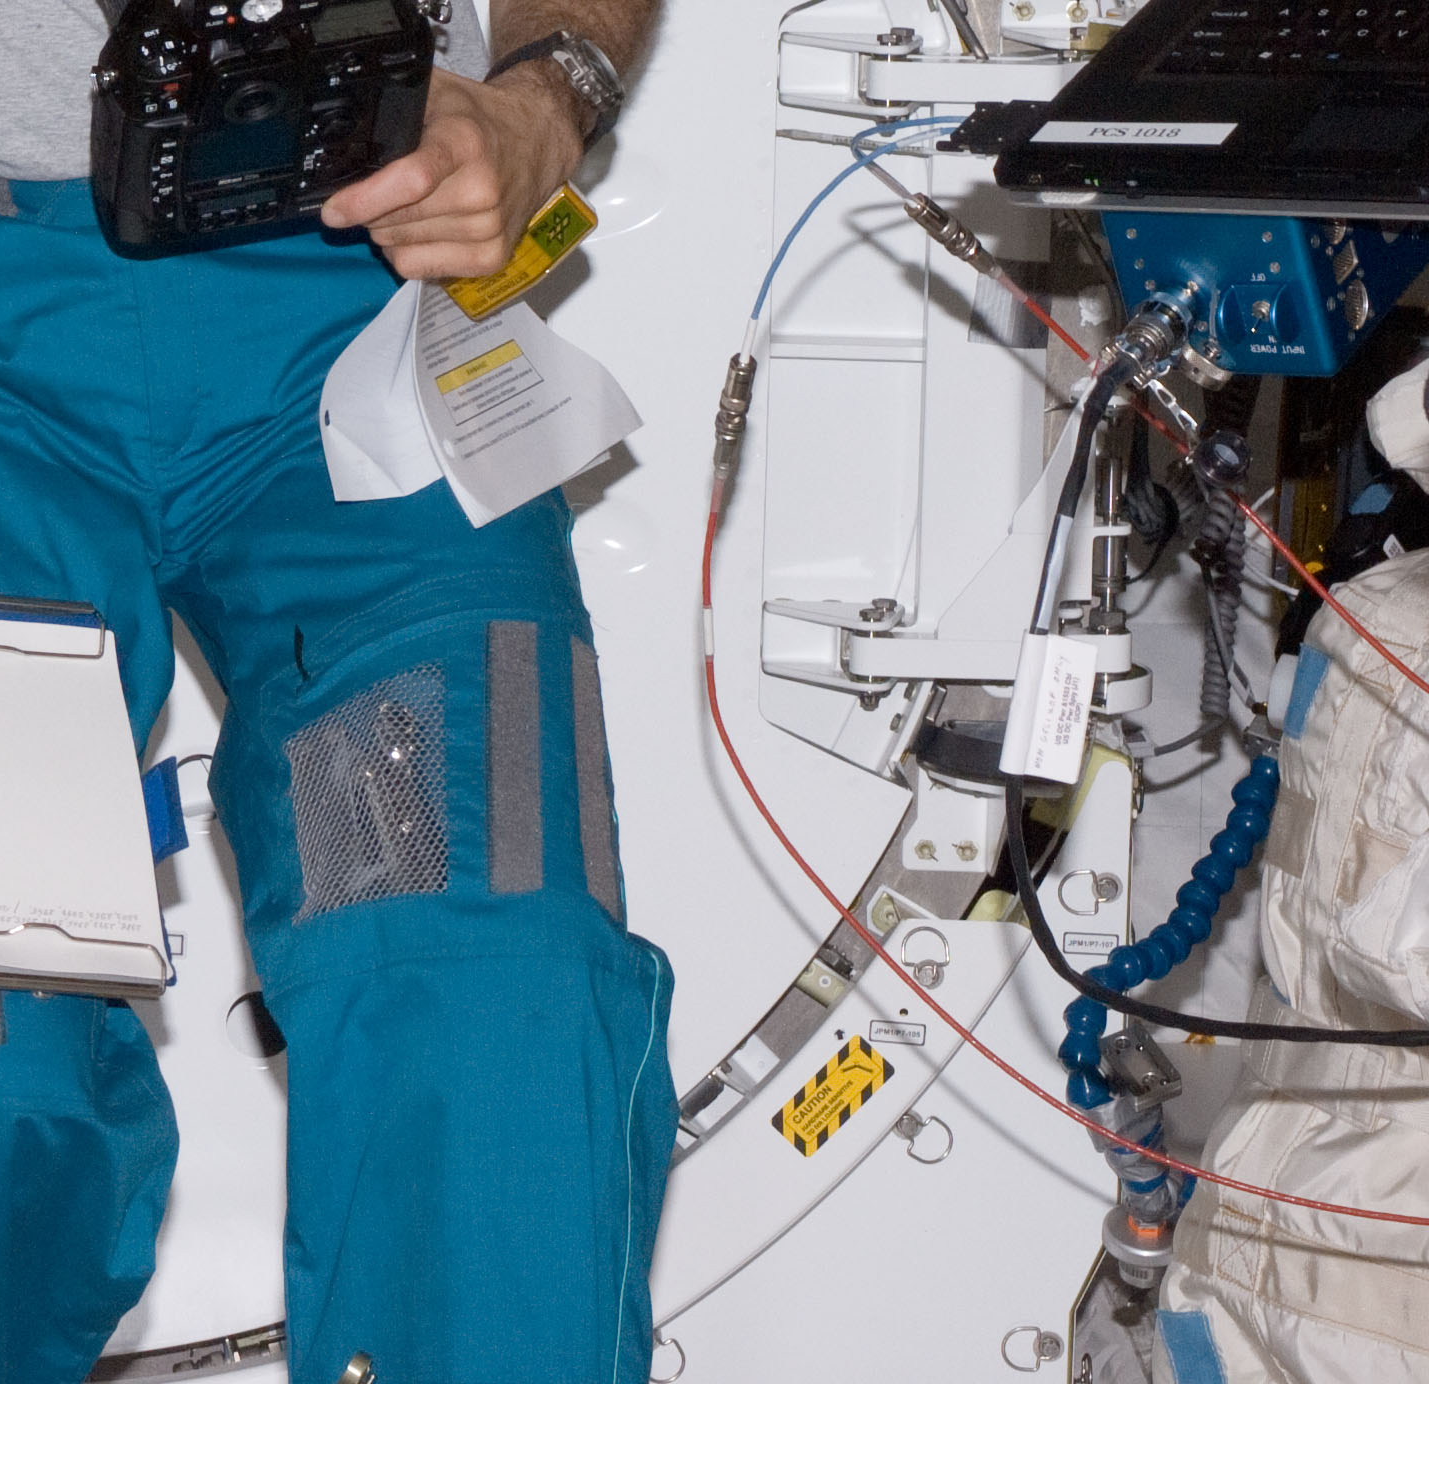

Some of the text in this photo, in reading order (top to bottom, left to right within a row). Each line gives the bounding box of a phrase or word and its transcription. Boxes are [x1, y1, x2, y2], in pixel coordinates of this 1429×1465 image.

[1279, 8, 1290, 16] A
[1318, 9, 1330, 17] S
[1317, 29, 1330, 37] X
[1089, 127, 1182, 138] PCS 1018
[1251, 272, 1266, 281] OFF
[1251, 344, 1306, 354] INPUT POWER
[791, 1084, 833, 1126] CAUTION
